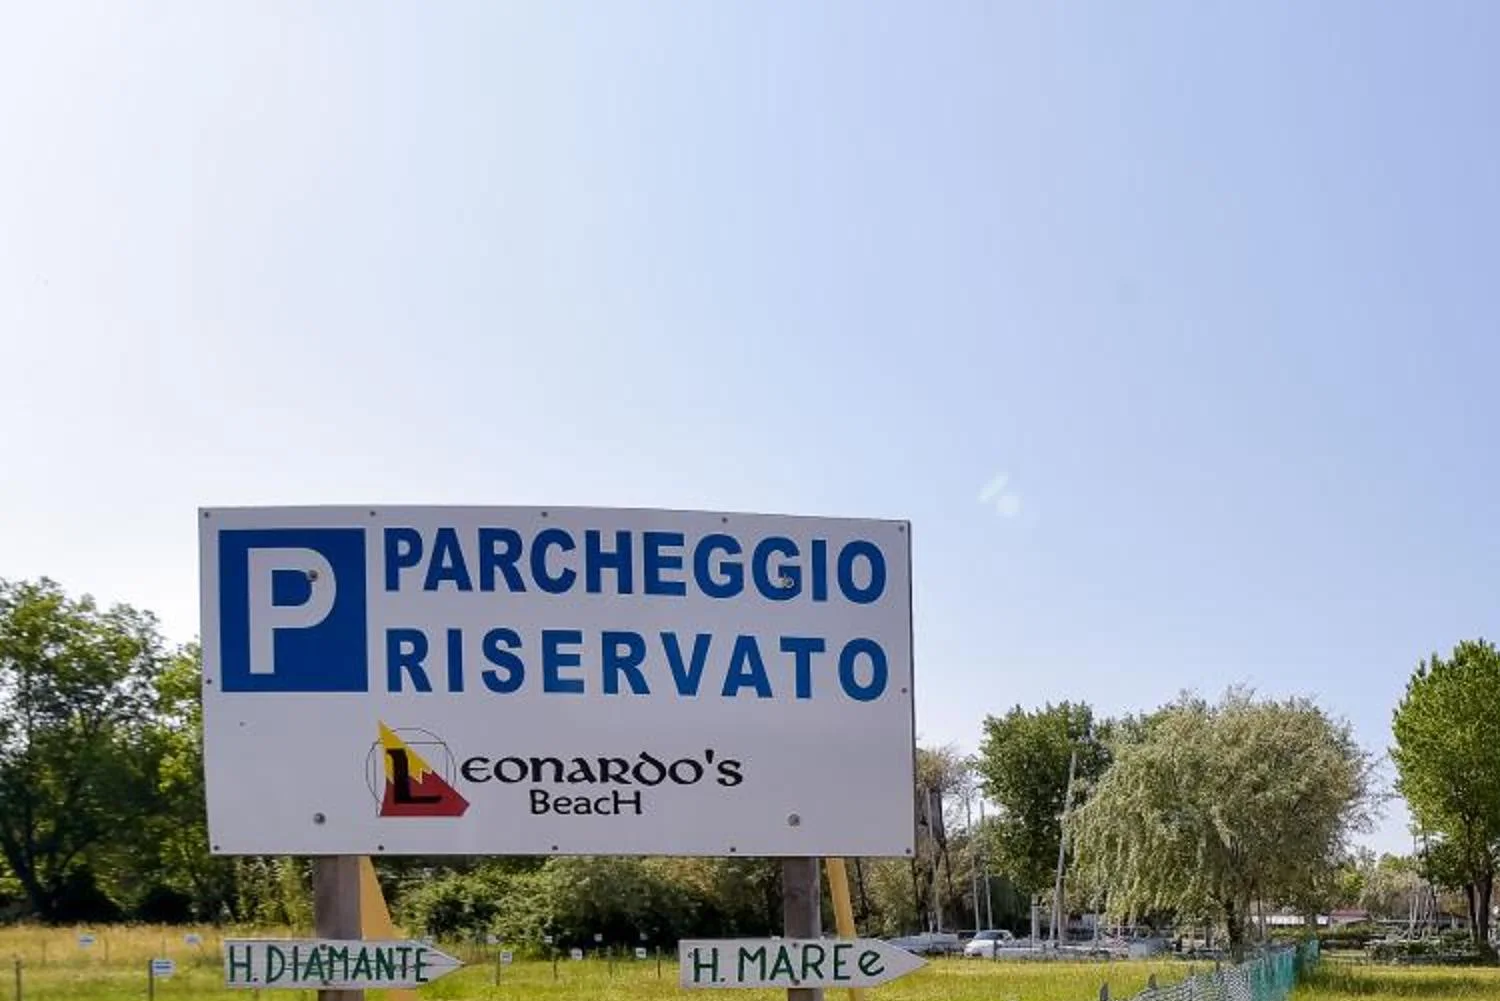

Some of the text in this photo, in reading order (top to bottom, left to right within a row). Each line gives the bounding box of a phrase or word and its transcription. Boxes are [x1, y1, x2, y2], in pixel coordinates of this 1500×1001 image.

[384, 528, 886, 604] PARCHEGGIO
[247, 547, 337, 675] P
[387, 628, 888, 701] RISERVATO
